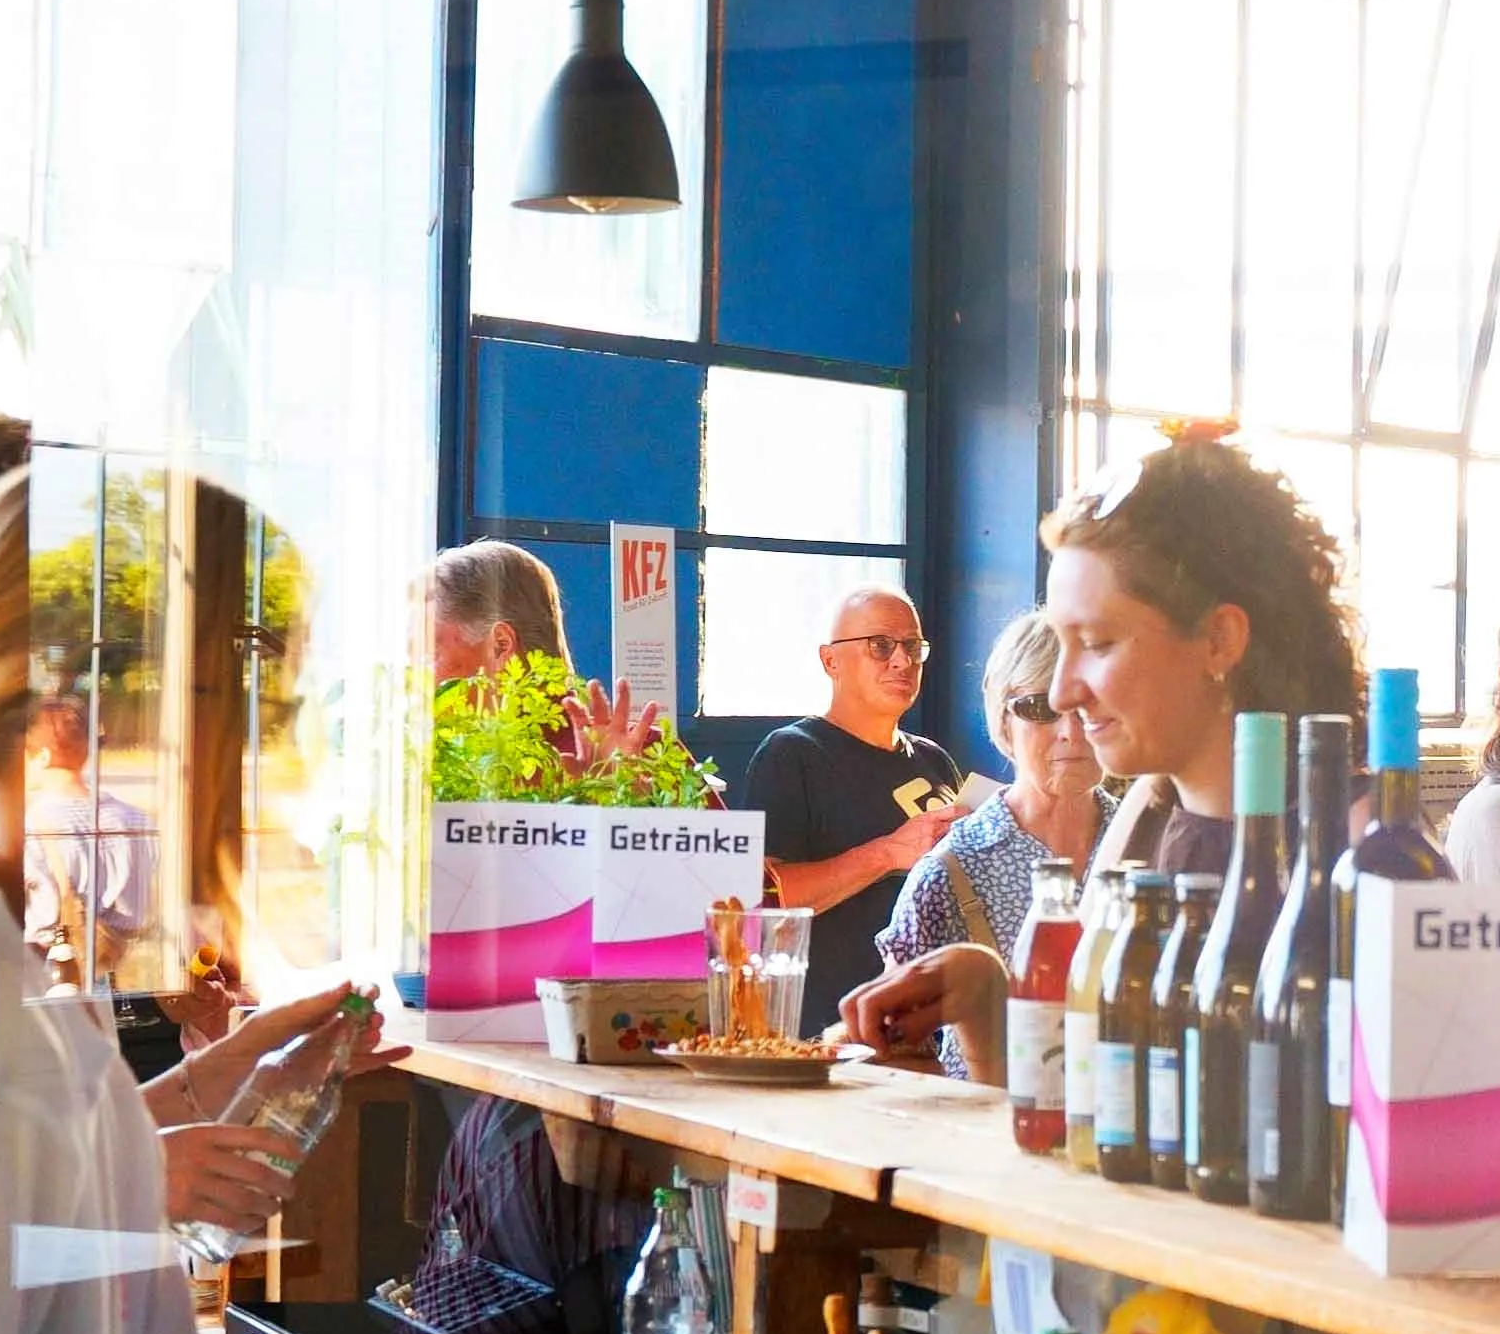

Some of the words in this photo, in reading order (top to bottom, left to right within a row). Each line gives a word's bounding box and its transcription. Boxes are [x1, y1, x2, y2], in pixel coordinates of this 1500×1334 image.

[620, 539, 668, 602] KFZ
[446, 818, 587, 847] Getränke
[611, 824, 749, 854] Getränke
